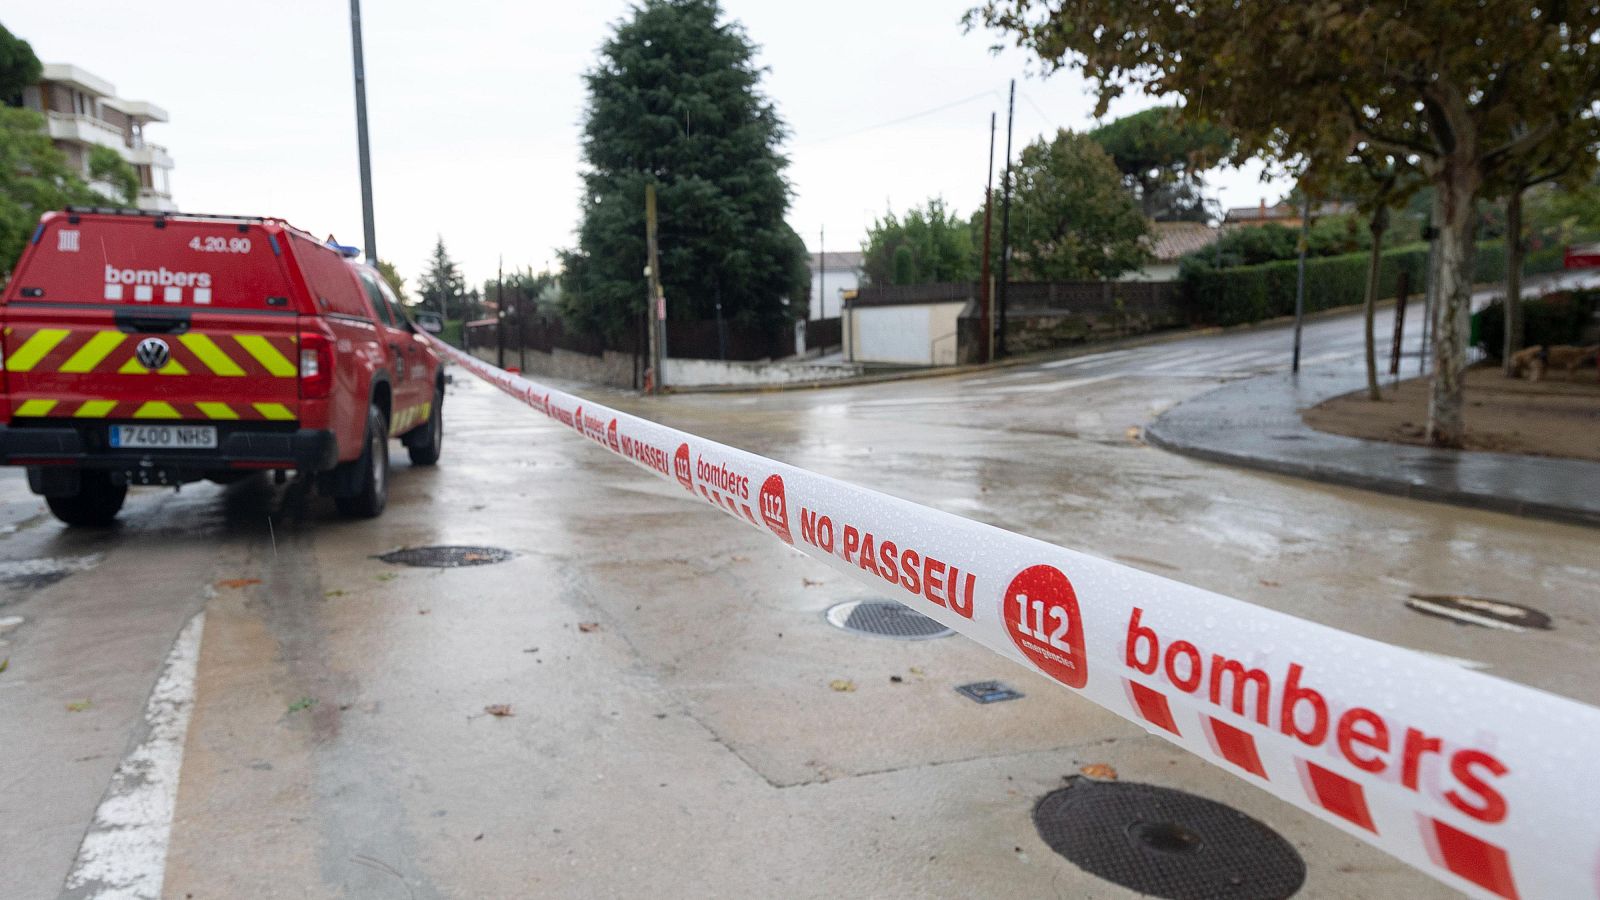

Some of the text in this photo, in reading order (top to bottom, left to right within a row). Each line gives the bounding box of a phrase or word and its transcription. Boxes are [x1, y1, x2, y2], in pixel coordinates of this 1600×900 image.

[189, 236, 251, 254] 4.20.90
[105, 263, 212, 287] bombers
[123, 427, 213, 445] 7400 NHS
[635, 439, 669, 476] PASSEU
[676, 457, 689, 480] 112
[697, 453, 749, 500] bombers
[763, 492, 783, 524] 112
[801, 507, 977, 621] NO PASSEU
[1015, 594, 1071, 654] 112
[1125, 606, 1510, 824] bombers
